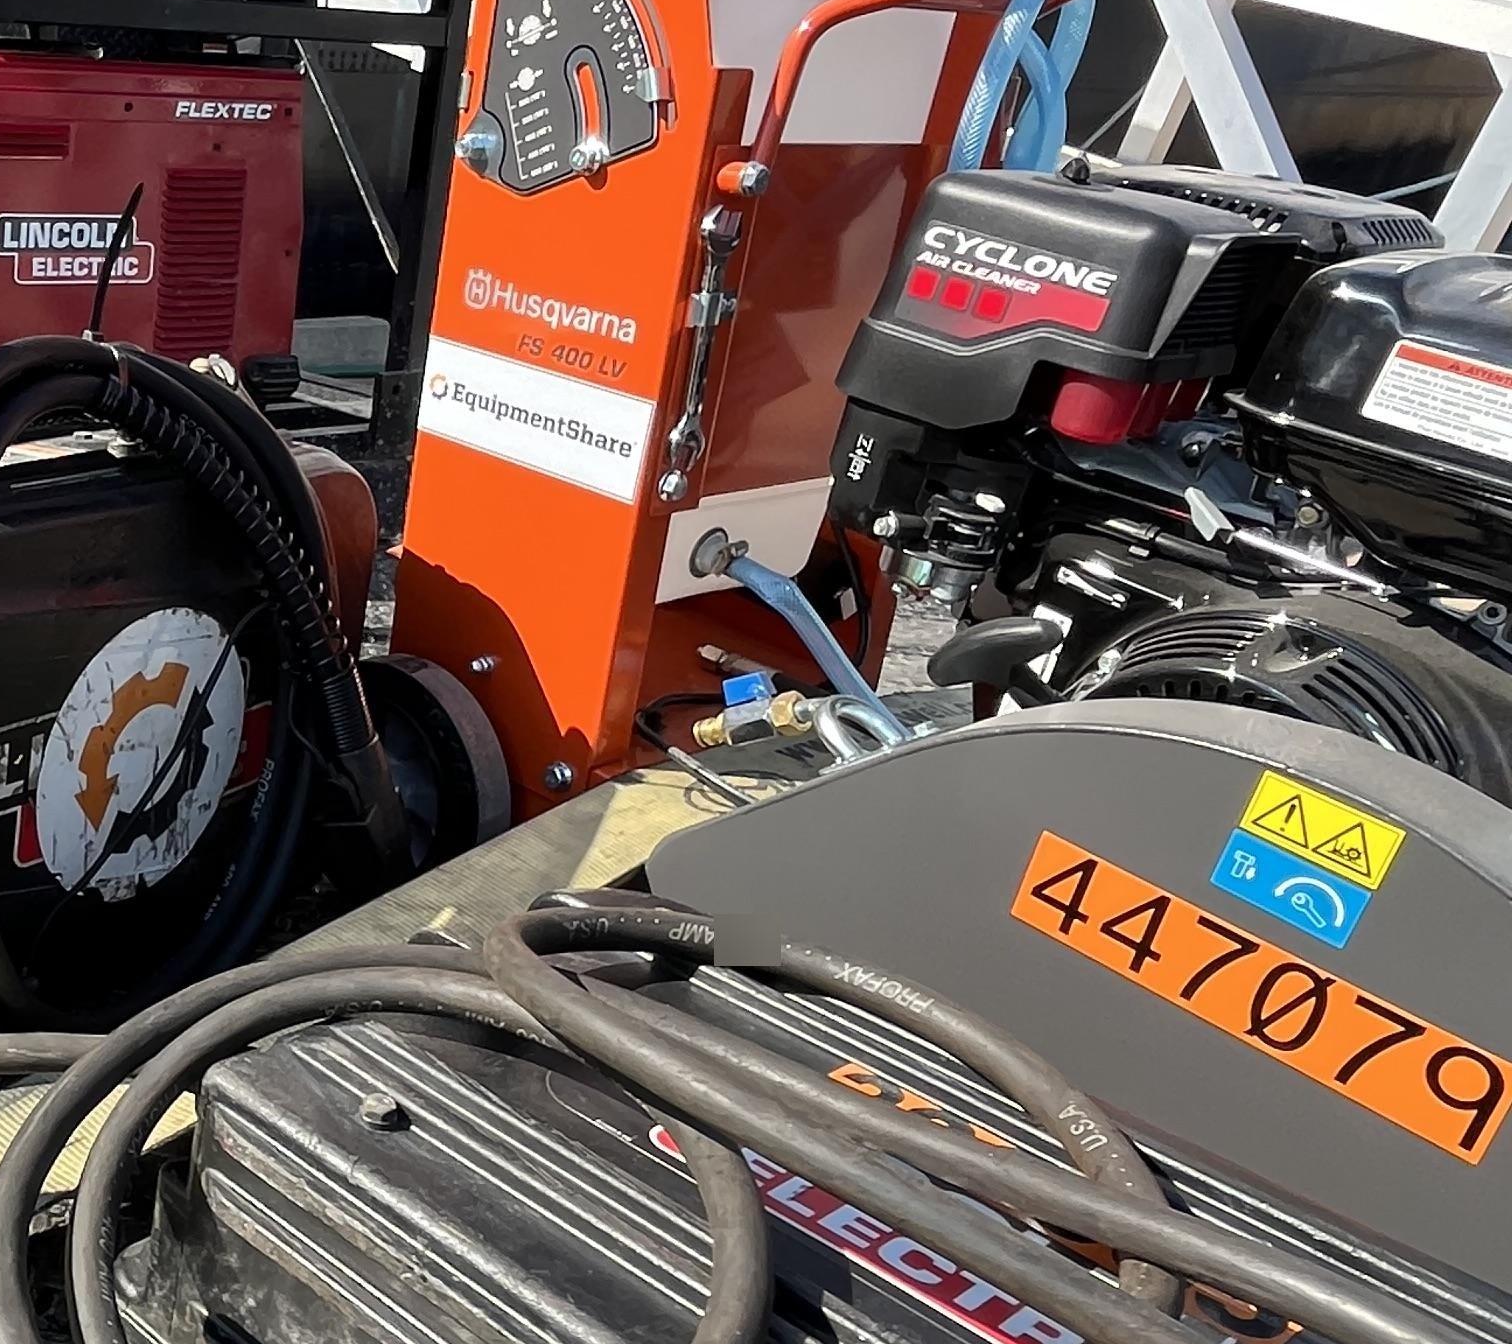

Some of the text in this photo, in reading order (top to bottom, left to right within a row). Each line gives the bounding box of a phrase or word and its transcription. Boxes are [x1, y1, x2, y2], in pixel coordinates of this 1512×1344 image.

[175, 100, 274, 121] FLEXTEC
[31, 256, 139, 278] ELECTIC
[915, 250, 1041, 296] AIR CLEANER
[922, 225, 1118, 298] CYCLONE
[490, 279, 637, 346] Husqvarna
[517, 335, 627, 378] FS 400 LV
[450, 382, 633, 459] EquipmentShare
[835, 961, 935, 1016] PROFAX
